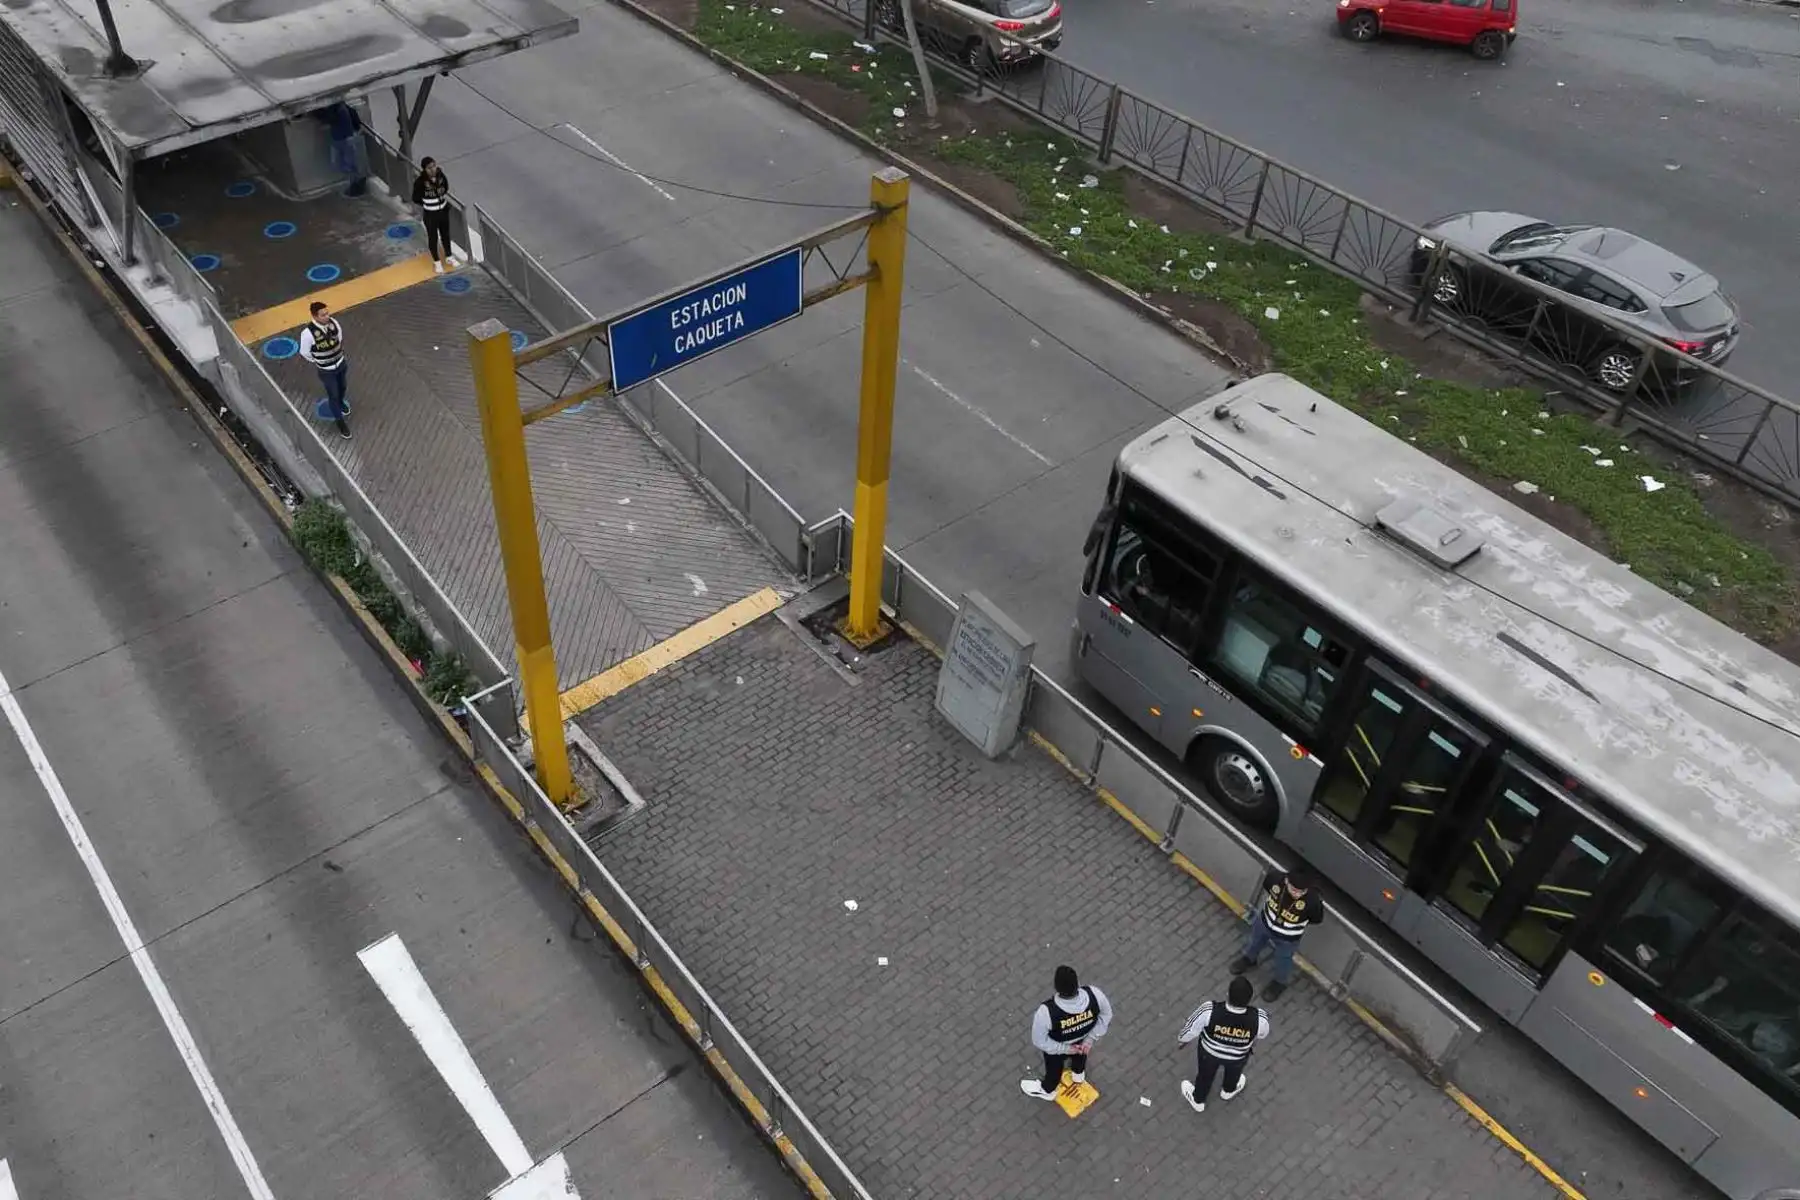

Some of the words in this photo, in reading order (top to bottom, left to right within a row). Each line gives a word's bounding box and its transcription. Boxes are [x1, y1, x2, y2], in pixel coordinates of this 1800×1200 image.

[671, 282, 747, 330] ESTACION
[674, 310, 745, 354] CAQUETA
[1060, 1009, 1093, 1029] POLICIA
[1213, 1024, 1251, 1038] POLICIA
